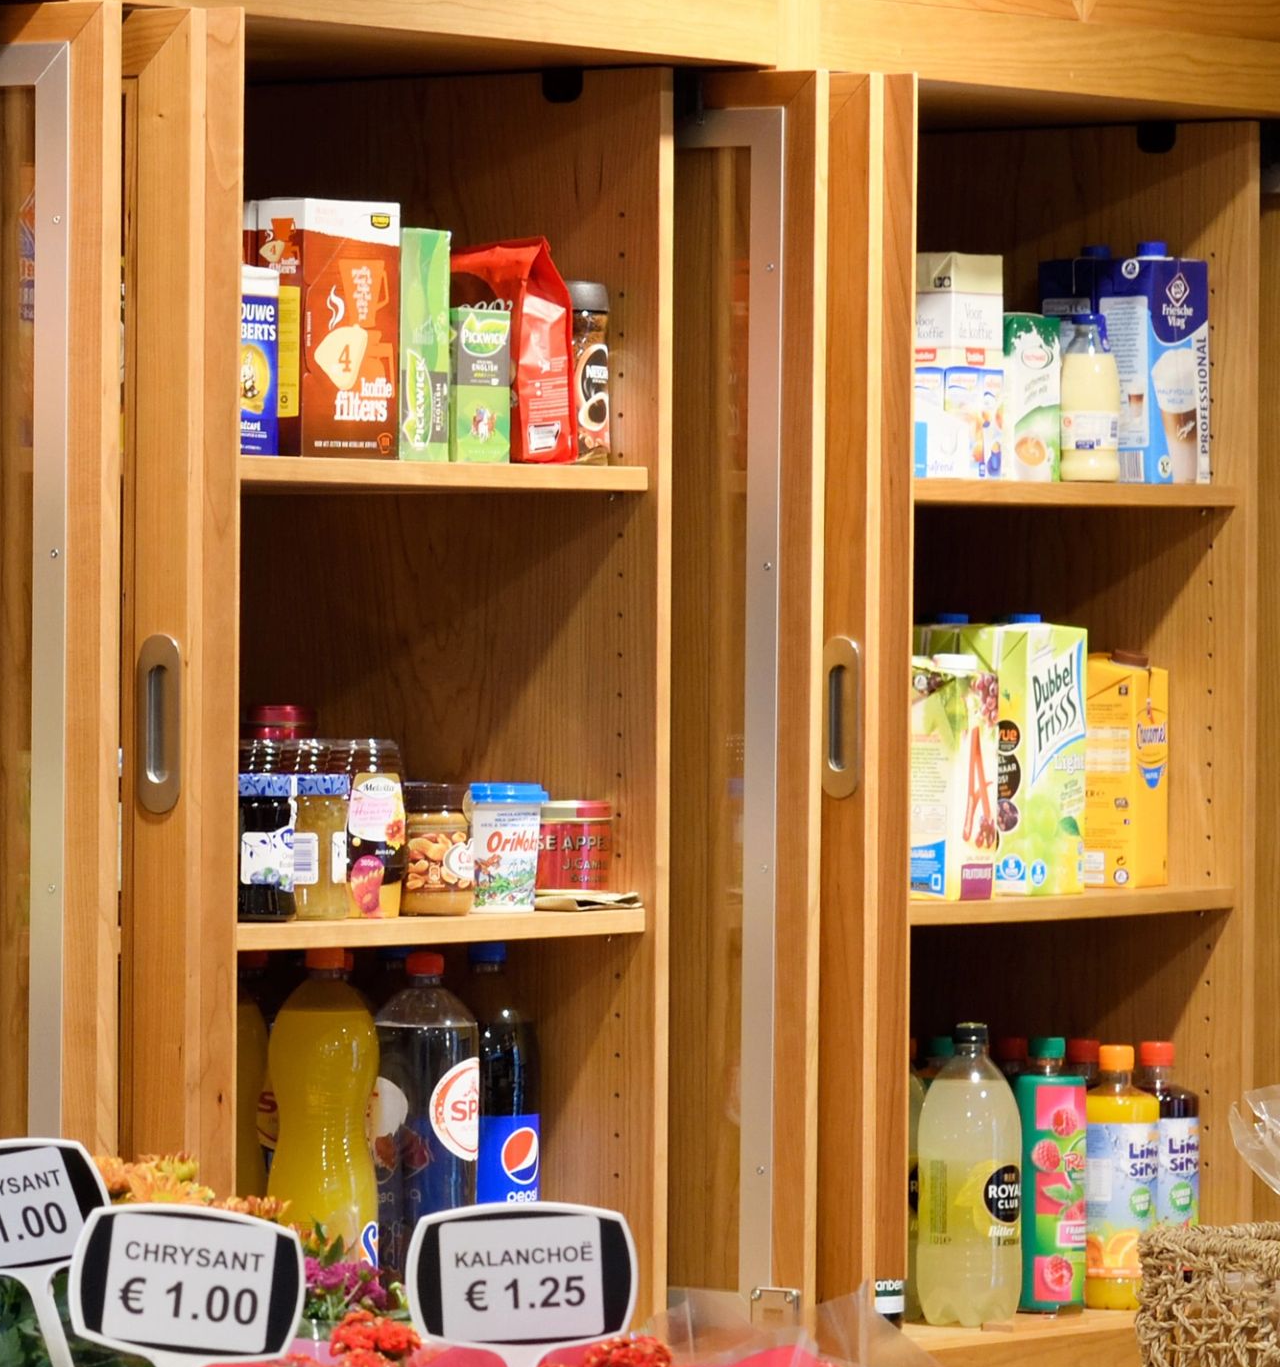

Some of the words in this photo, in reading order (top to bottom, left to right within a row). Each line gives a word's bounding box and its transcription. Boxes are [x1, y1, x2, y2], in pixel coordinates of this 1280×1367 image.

[1162, 303, 1194, 318] Friesche
[1167, 314, 1186, 330] Vlag
[460, 328, 508, 346] PICKWICK
[339, 344, 352, 373] 4
[471, 362, 499, 372] ENGLISH
[360, 377, 393, 398] koffie
[1195, 336, 1209, 456] PROFESSIONAL
[334, 389, 388, 422] filters
[413, 356, 426, 450] PICKWICK
[1032, 652, 1075, 710] Dubbel
[1036, 685, 1078, 753] Frisss
[1135, 722, 1168, 751] Chocomel
[1053, 753, 1086, 776] Light
[506, 1186, 538, 1203] pepsi
[988, 1184, 1021, 1200] ROYA
[988, 1224, 1016, 1238] Bitter
[124, 1240, 266, 1273] CHRYSANT
[453, 1241, 595, 1270] KALANCHOË
[118, 1275, 147, 1316] €
[163, 1278, 260, 1327] 1.00
[463, 1279, 489, 1314] €
[503, 1274, 587, 1311] 1.25
